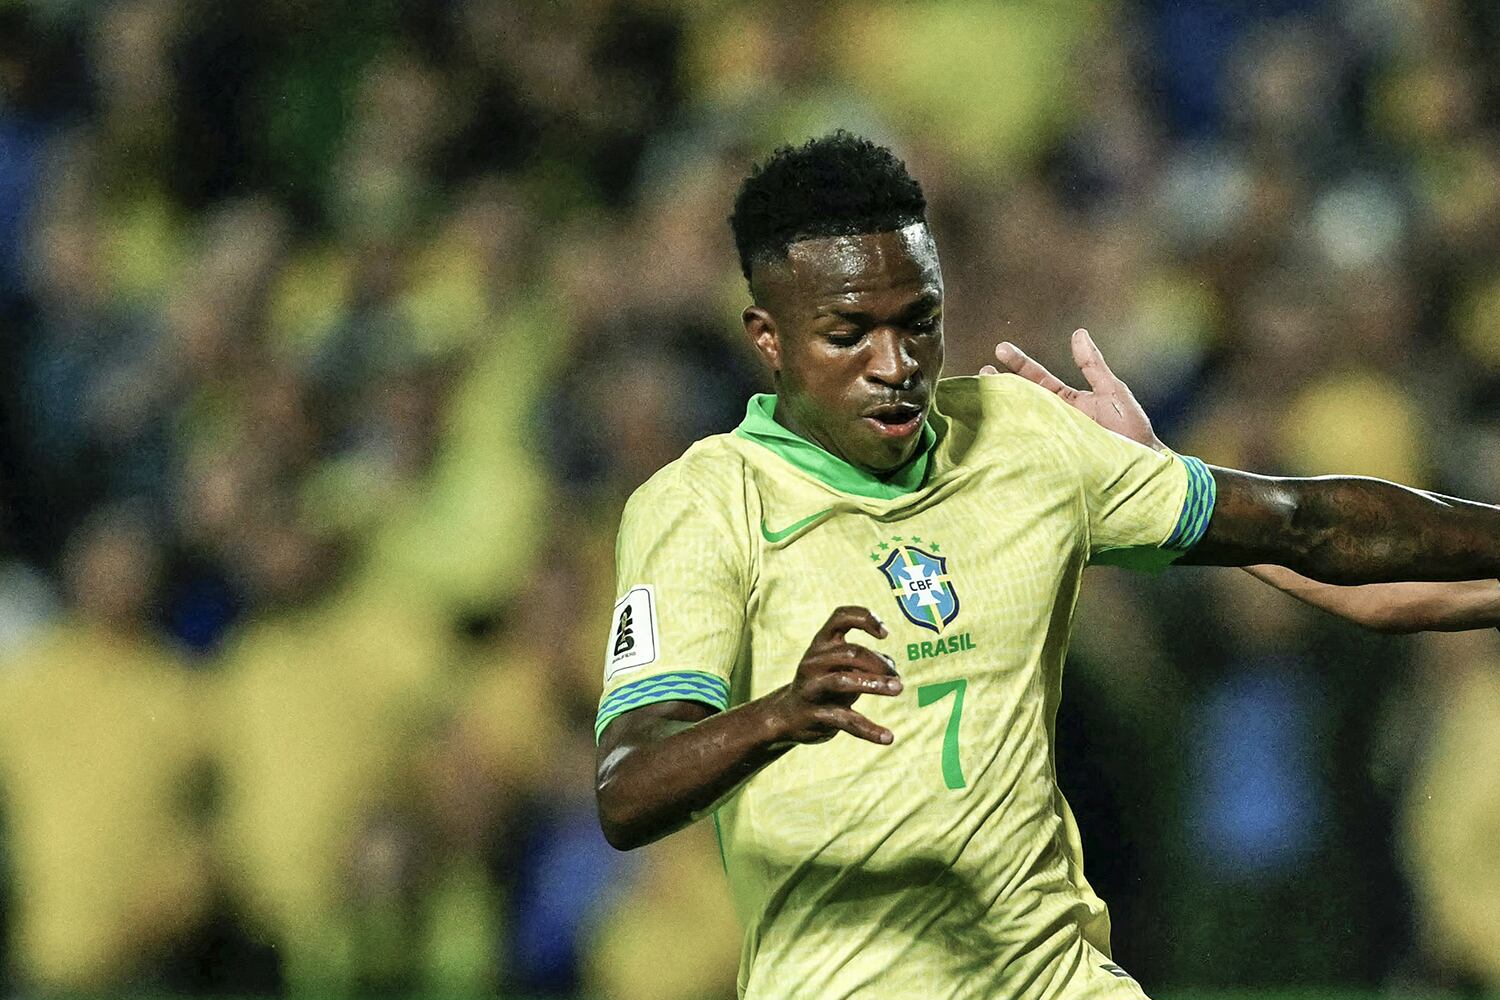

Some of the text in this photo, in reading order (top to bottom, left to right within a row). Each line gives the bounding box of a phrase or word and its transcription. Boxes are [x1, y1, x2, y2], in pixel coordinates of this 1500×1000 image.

[909, 579, 933, 592] CBF
[906, 632, 976, 662] BRASIL
[917, 678, 968, 790] 7
